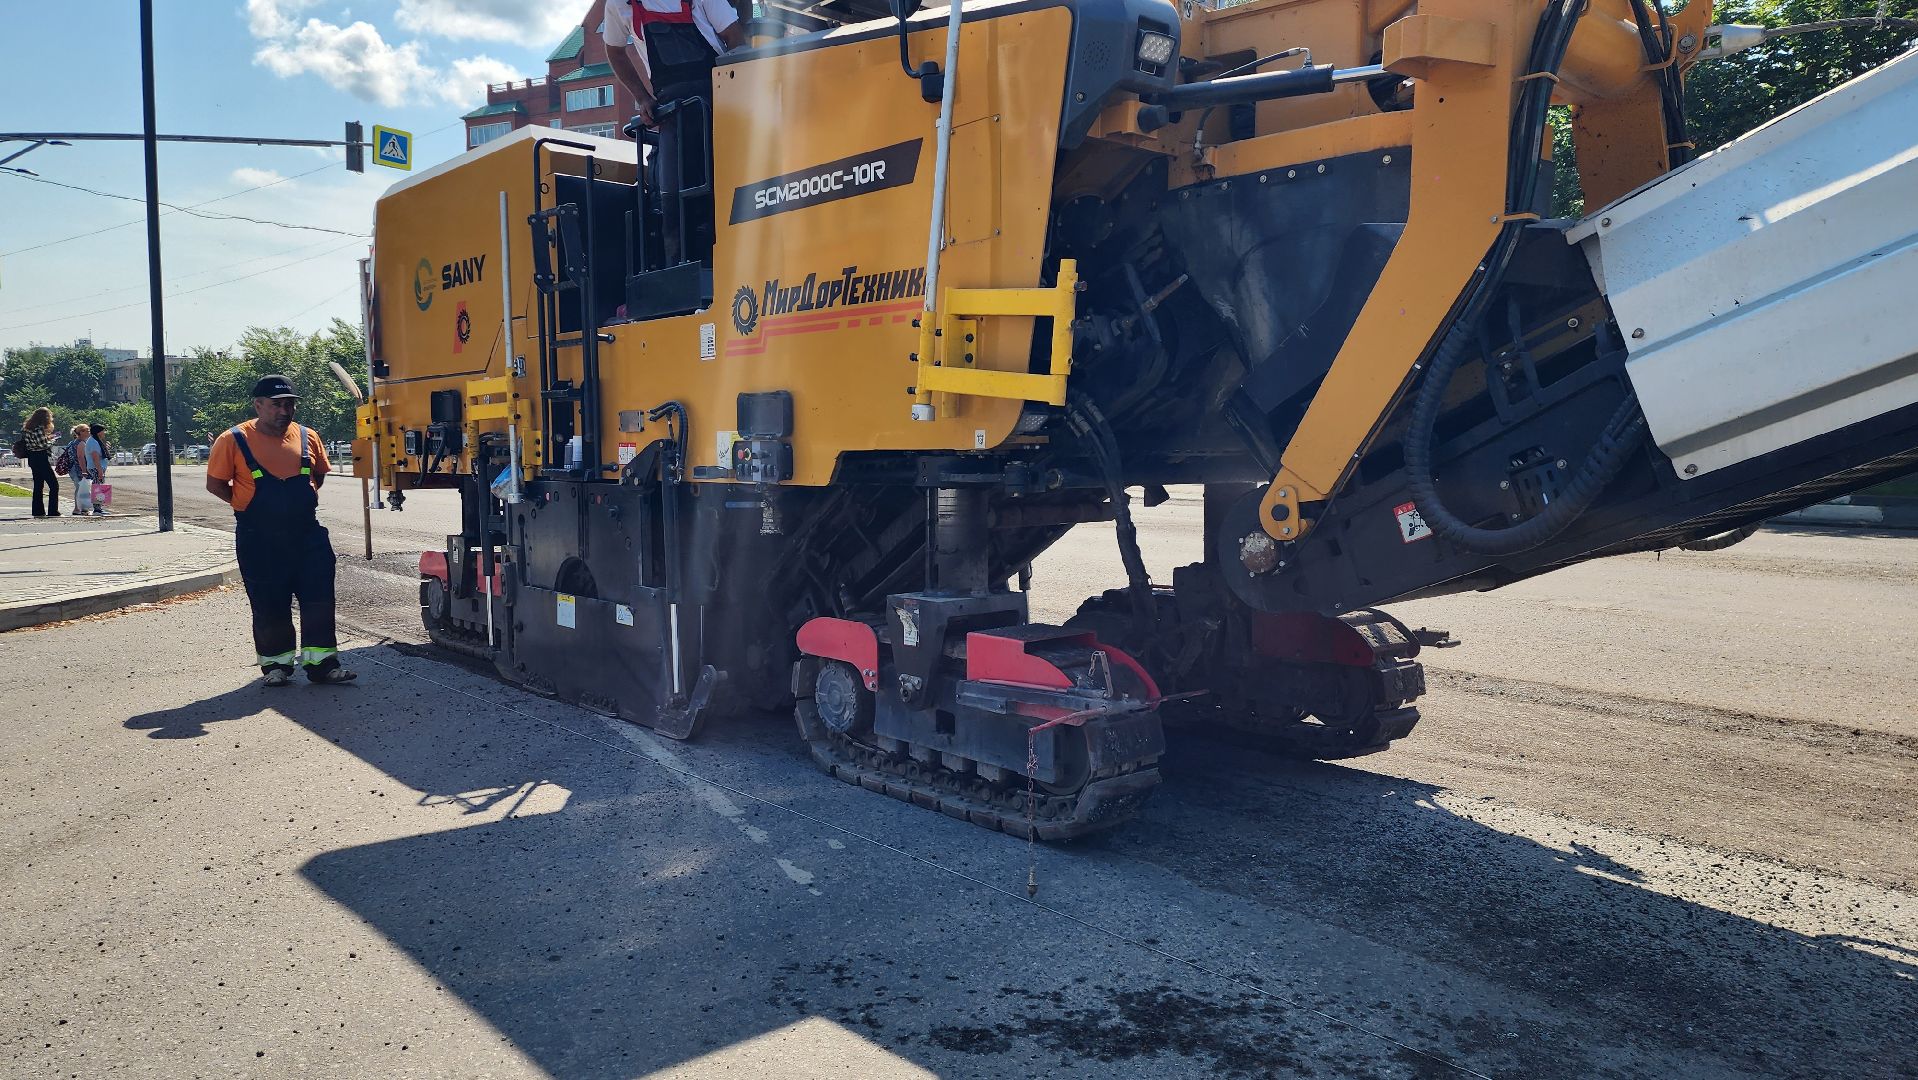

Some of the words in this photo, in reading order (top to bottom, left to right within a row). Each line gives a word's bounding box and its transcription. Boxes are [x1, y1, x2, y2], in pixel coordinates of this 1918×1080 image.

[755, 160, 886, 209] SCM2000C-10R
[441, 254, 486, 290] SANY
[761, 265, 938, 316] МирДорТехник
